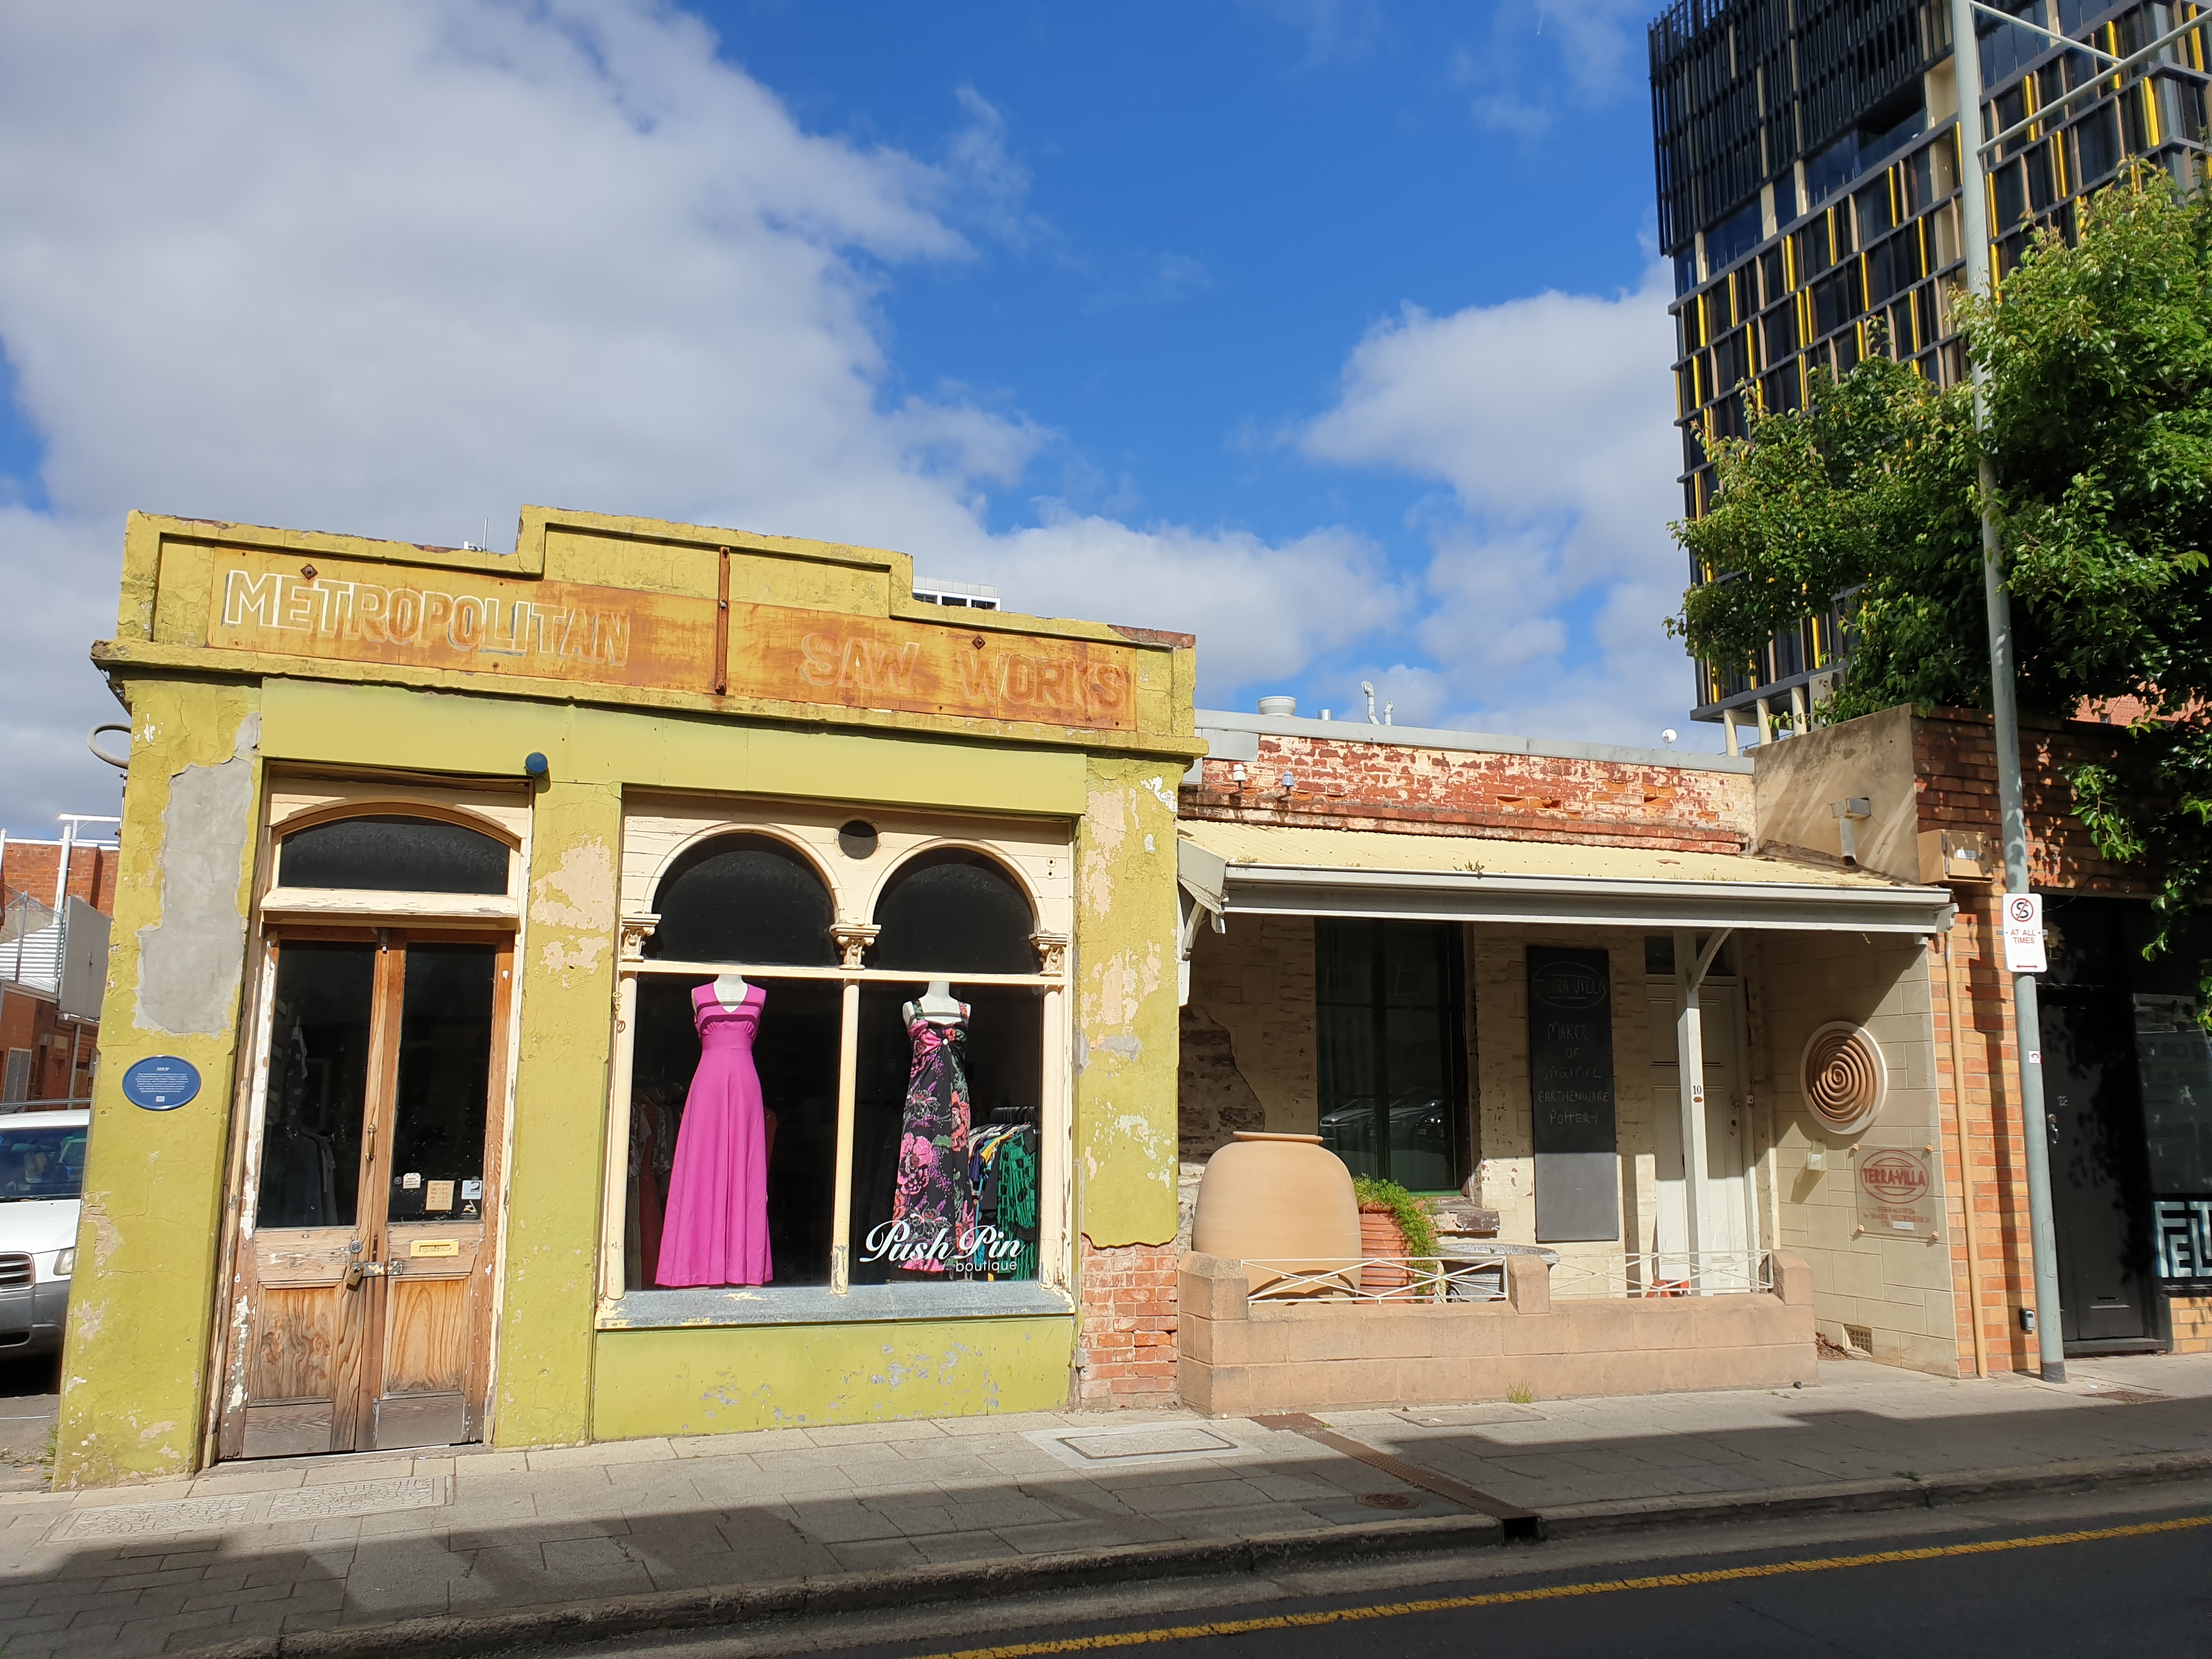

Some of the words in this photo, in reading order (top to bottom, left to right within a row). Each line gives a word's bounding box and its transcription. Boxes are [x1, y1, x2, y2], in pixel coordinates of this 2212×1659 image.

[223, 569, 631, 667] METROPOLITAN
[801, 631, 919, 694] SAW
[957, 648, 1127, 713] WORKS
[1548, 1021, 1588, 1041] MAKER
[1565, 1048, 1579, 1058] OF
[1538, 1090, 1609, 1103] EARTHENWARE
[1693, 1085, 1702, 1094] 10
[1550, 1109, 1598, 1124] POTTERY
[1863, 1167, 1927, 1187] TERRA-VILLA
[859, 1220, 955, 1262] Push
[953, 1224, 1026, 1260] Pin
[956, 1260, 1018, 1273] boutique
